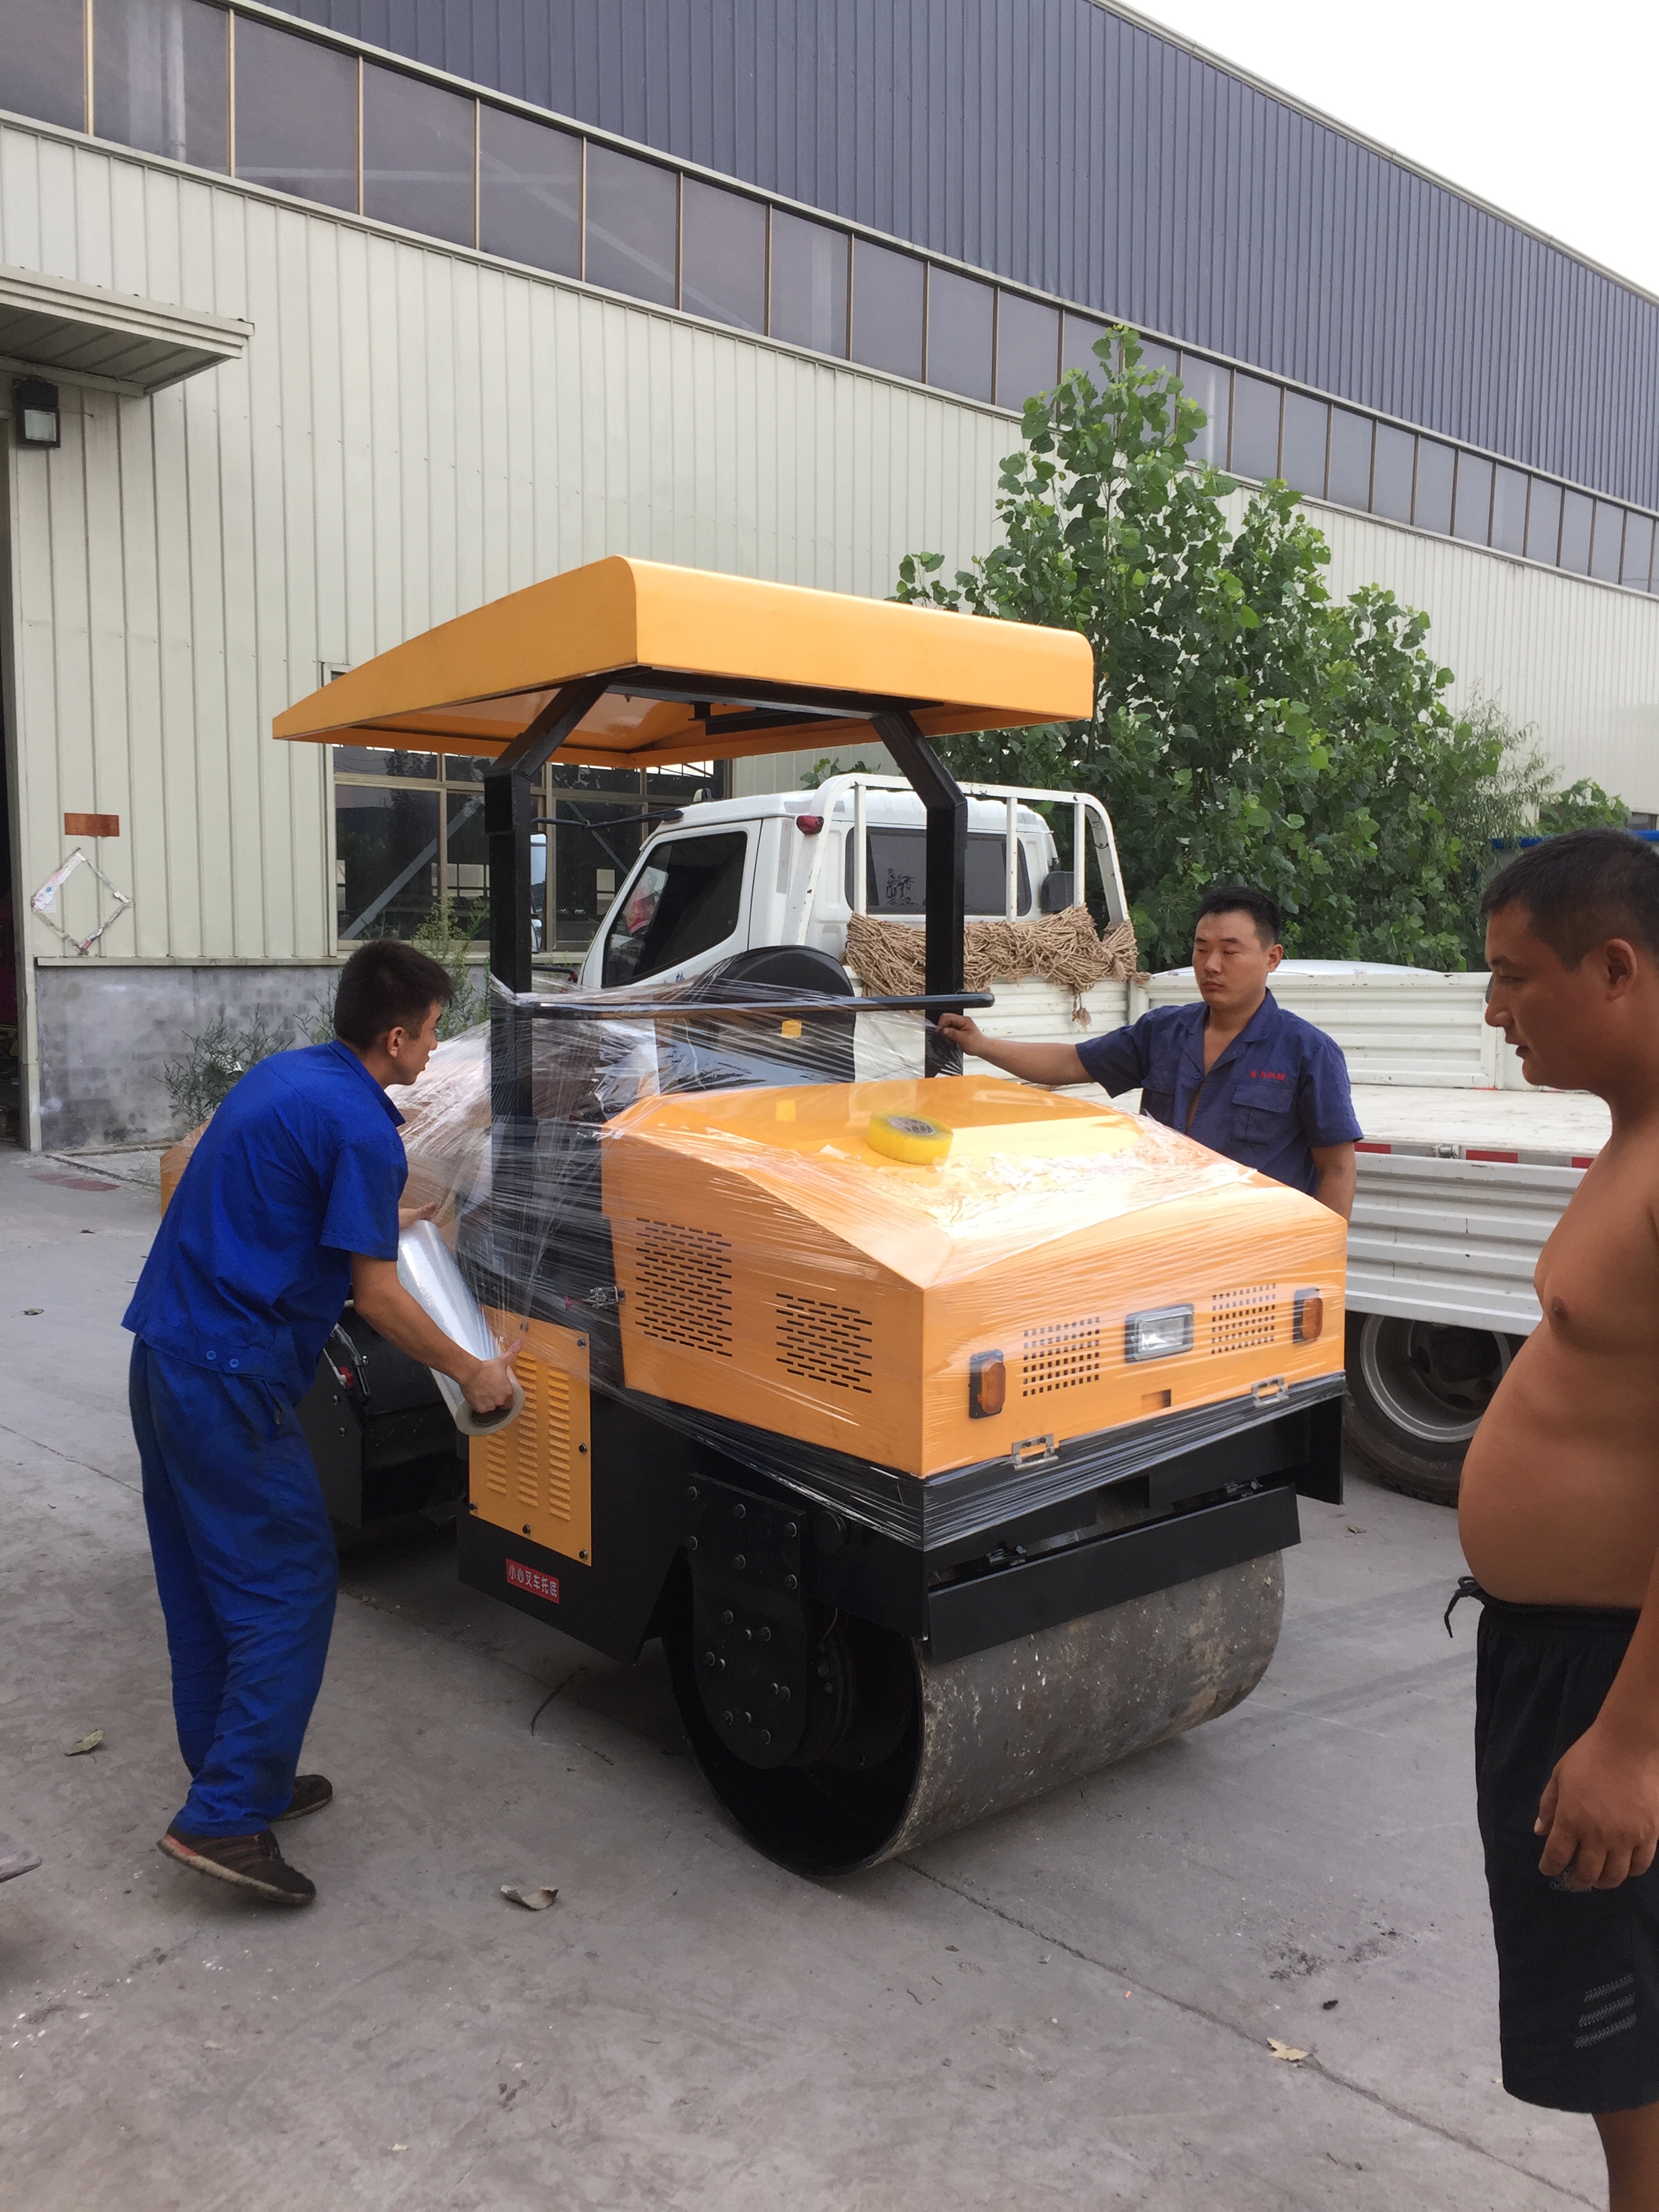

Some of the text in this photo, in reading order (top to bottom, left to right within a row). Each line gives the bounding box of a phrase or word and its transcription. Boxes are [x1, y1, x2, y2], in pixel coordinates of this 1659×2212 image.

[509, 1563, 557, 1598] 小心叉车托底
